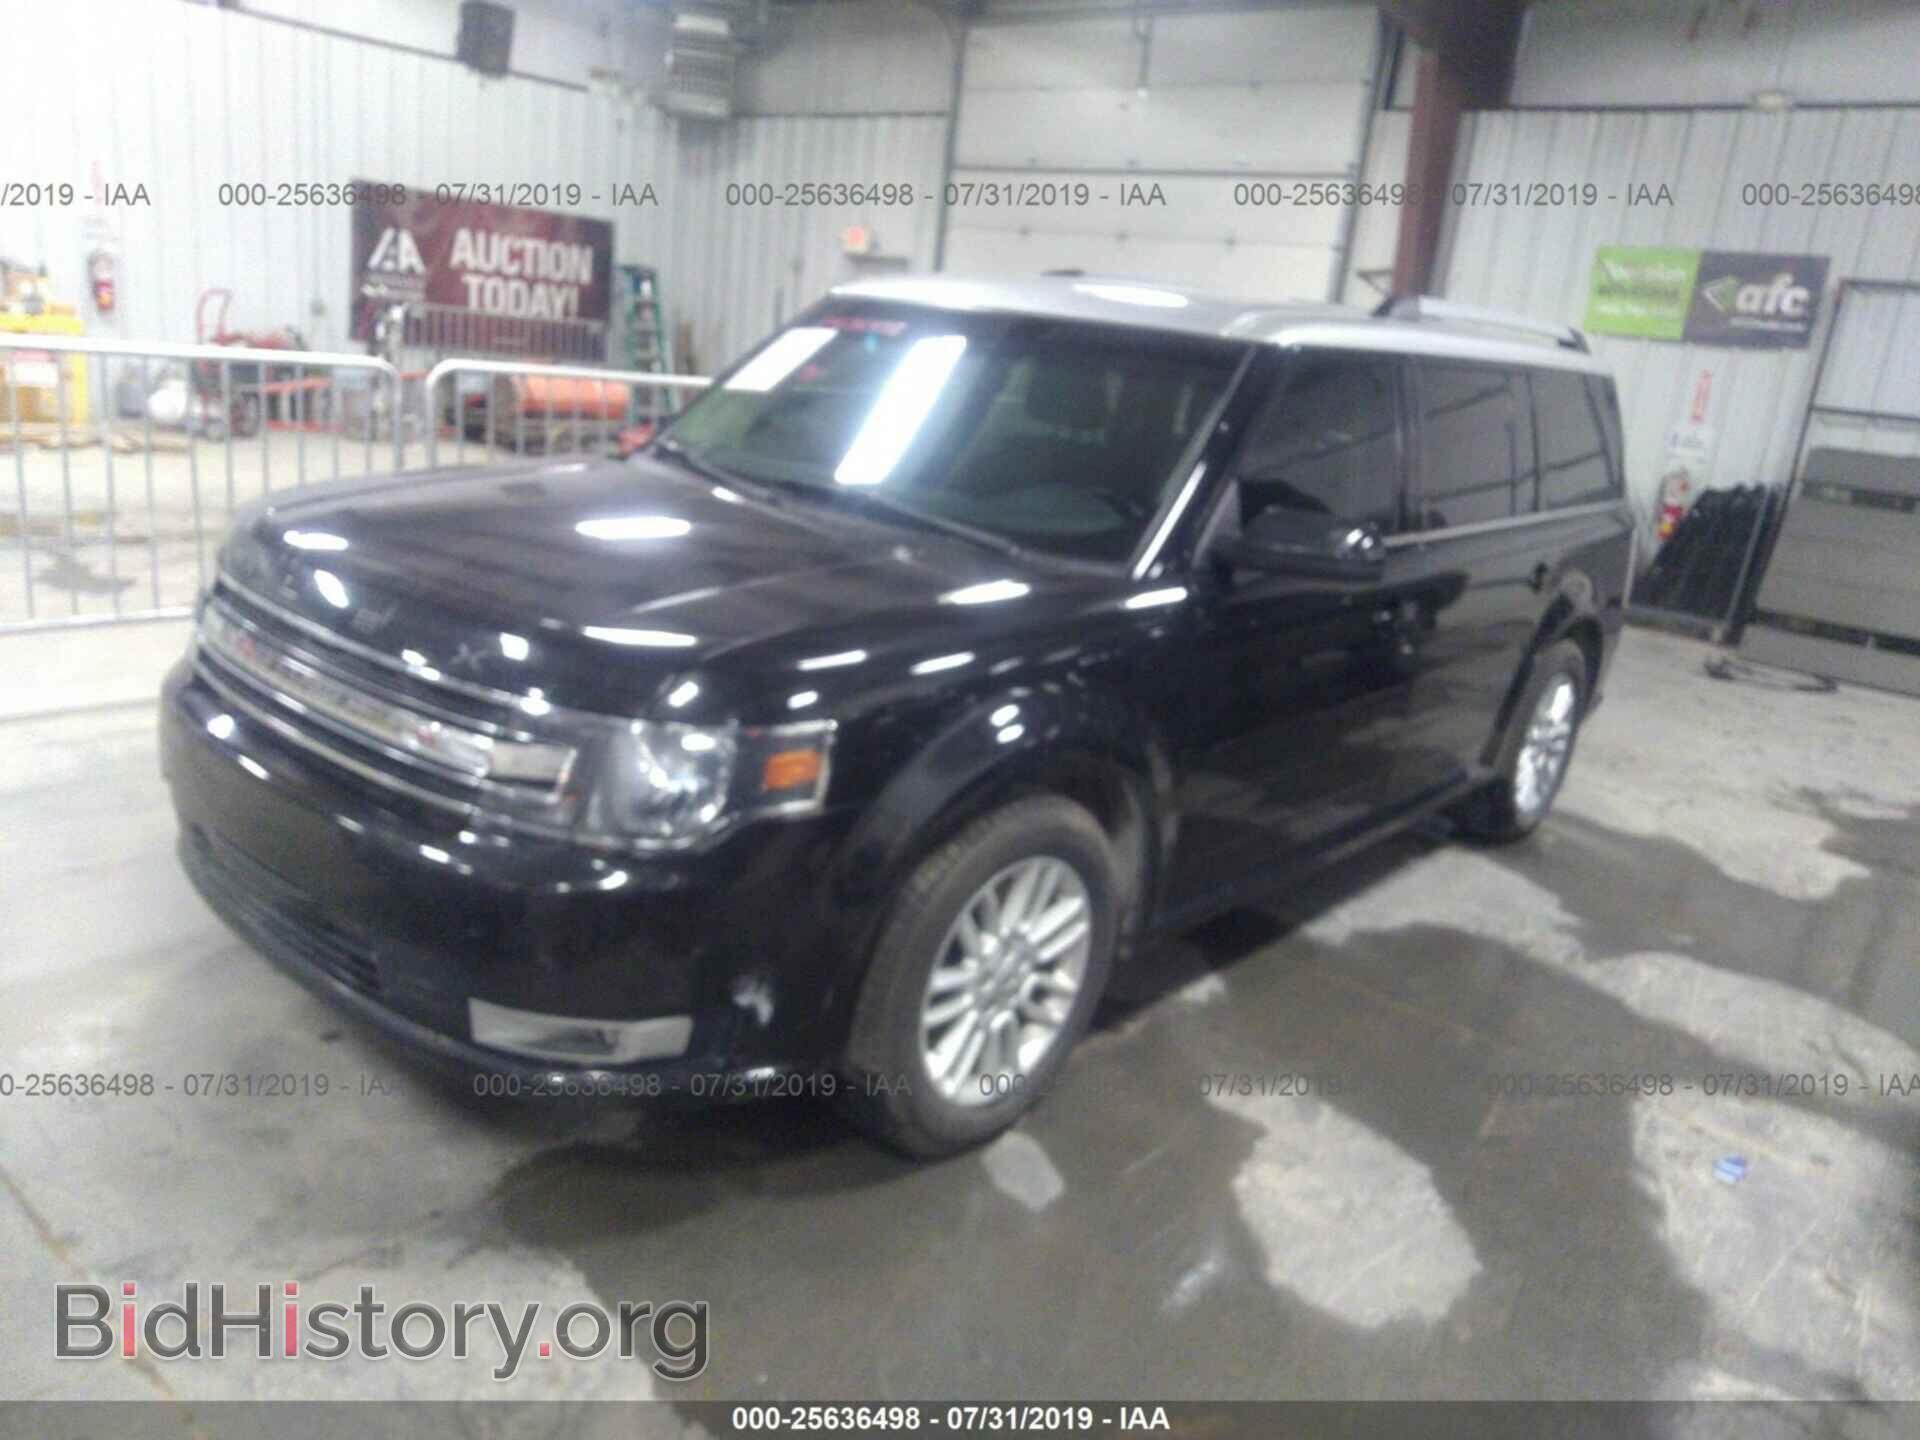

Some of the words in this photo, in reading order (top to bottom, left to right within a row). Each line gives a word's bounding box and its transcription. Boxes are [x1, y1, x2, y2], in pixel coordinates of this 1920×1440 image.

[449, 227, 593, 285] AUCTION
[461, 273, 579, 321] TODAY!
[1735, 273, 1810, 316] afc
